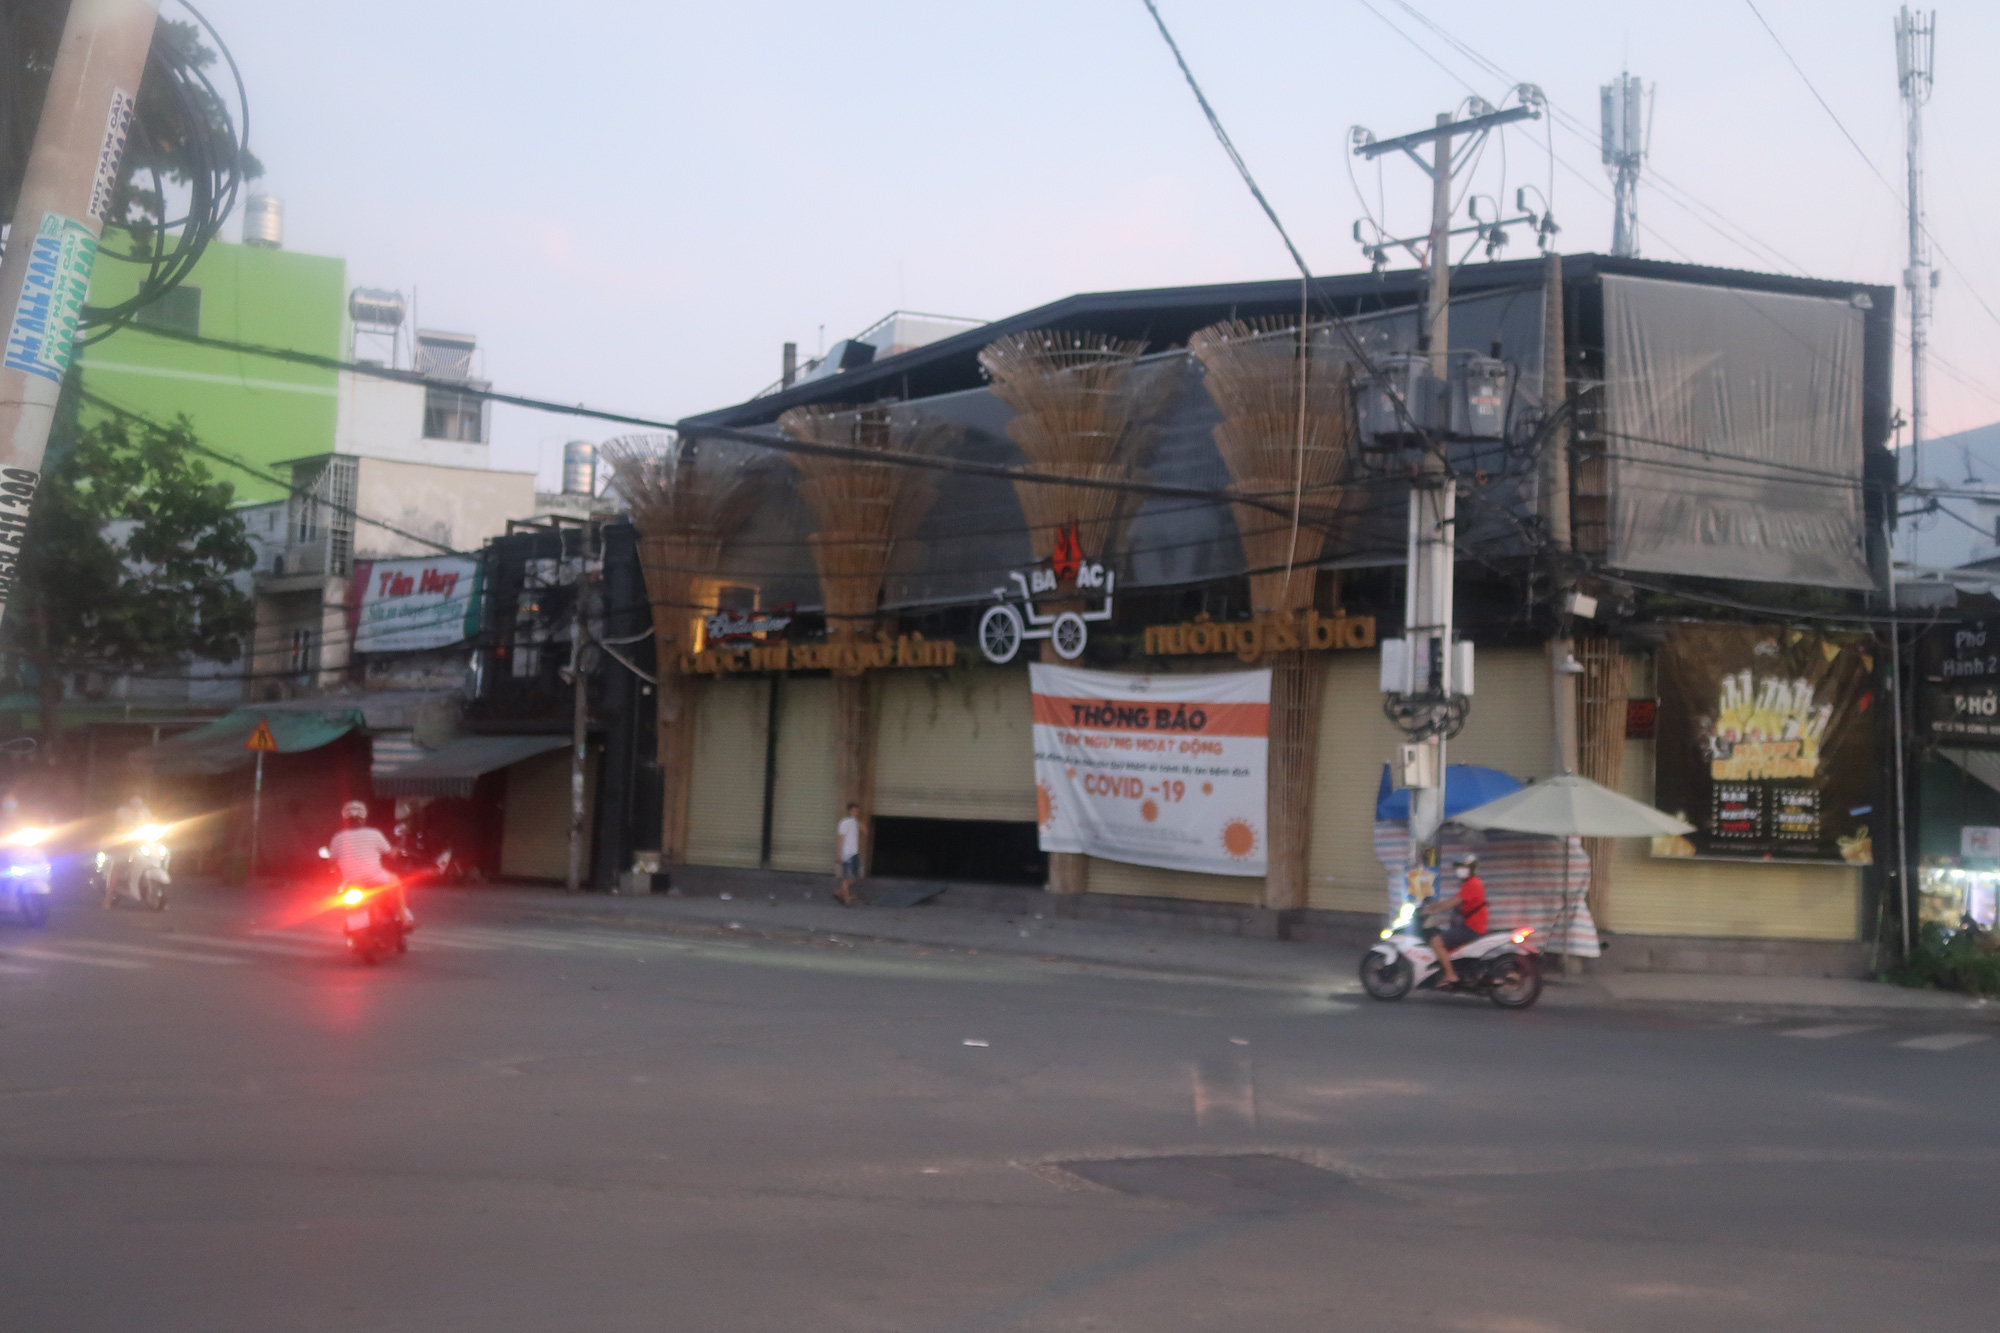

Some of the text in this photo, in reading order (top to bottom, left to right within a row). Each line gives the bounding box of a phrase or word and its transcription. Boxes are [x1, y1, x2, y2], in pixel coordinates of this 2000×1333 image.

[1031, 571, 1057, 592] BA
[1308, 608, 1375, 650] bia
[1955, 620, 1987, 648] Phở
[1071, 700, 1207, 730] THÔNG BÁO
[1085, 773, 1144, 799] COVID
